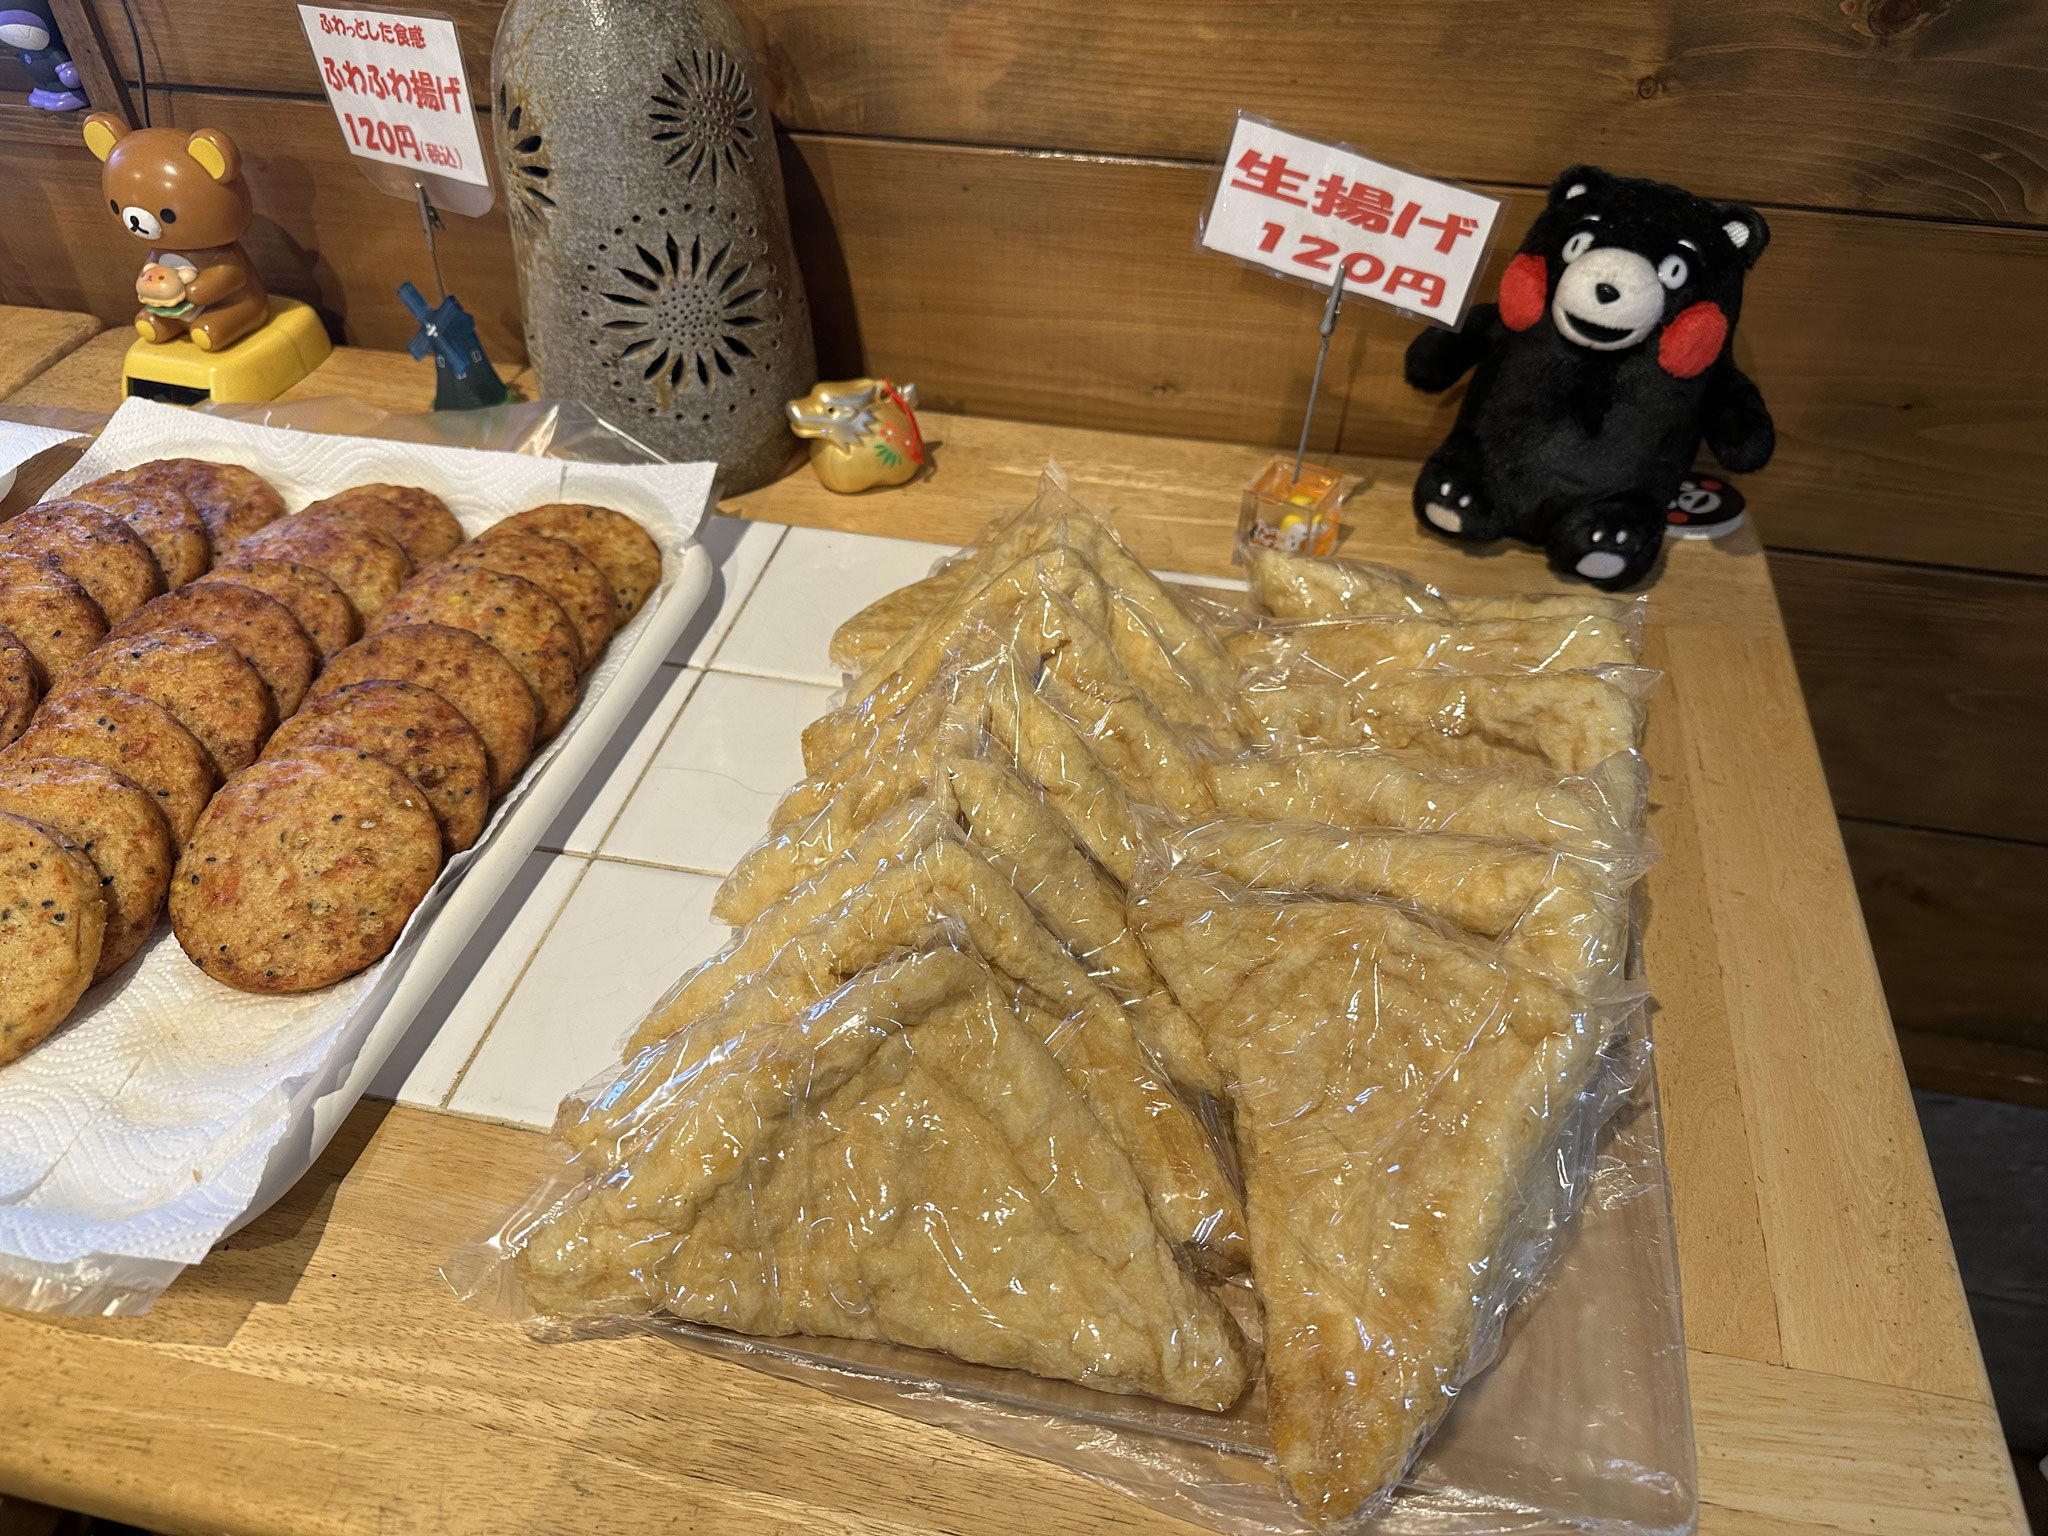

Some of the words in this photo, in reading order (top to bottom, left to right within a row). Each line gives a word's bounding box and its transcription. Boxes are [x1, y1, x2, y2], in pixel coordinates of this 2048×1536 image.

[319, 13, 426, 49] ふわっとした食感
[323, 56, 462, 114] ふわふわ揚げ
[1230, 149, 1479, 255] 生揚げ
[1257, 221, 1446, 308] 120円
